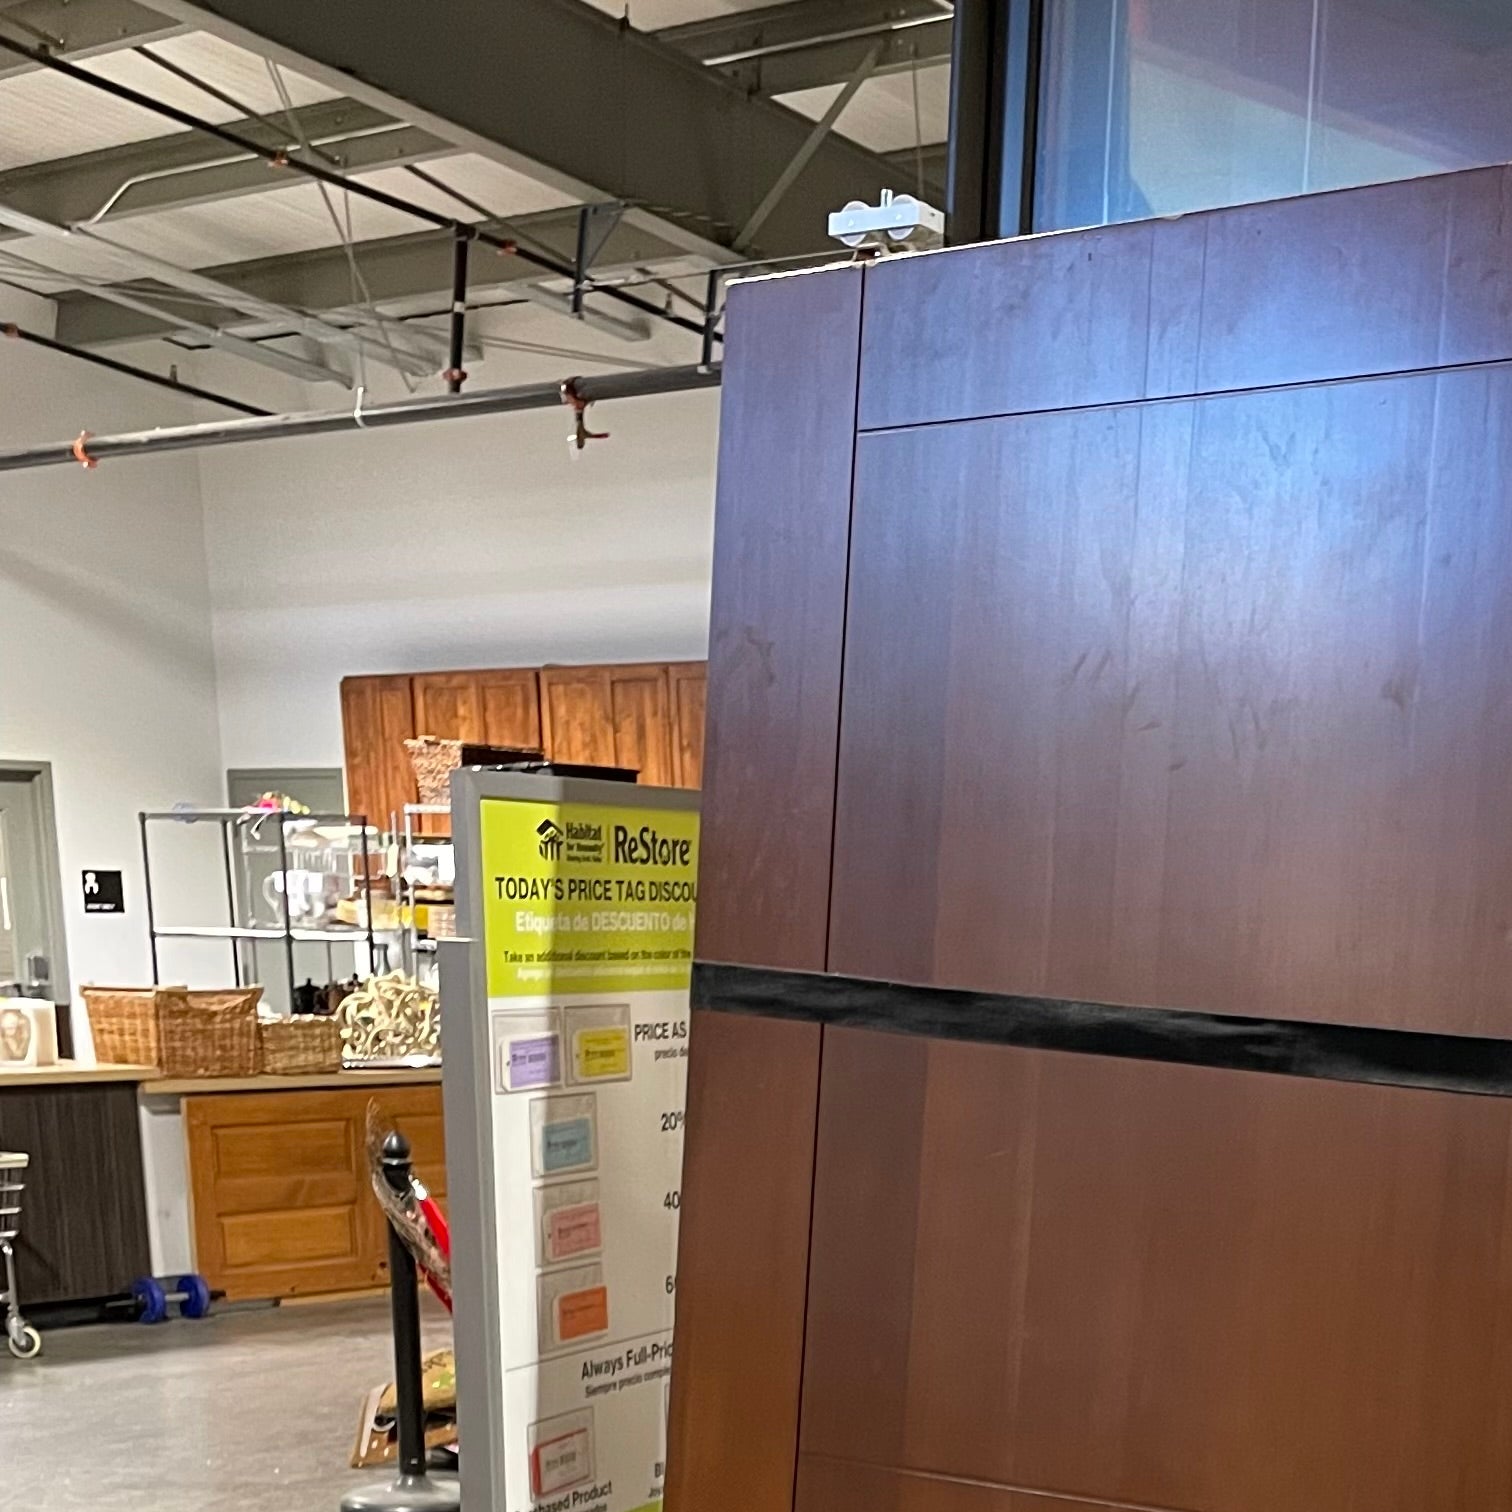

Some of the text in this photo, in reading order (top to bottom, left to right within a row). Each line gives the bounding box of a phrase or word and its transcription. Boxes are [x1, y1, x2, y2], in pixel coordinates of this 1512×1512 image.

[614, 825, 690, 866] ReStore
[495, 877, 564, 900] TODAY'S
[568, 879, 612, 901] PRICE
[615, 879, 645, 902] TAG
[516, 911, 570, 936] Etiqueta
[573, 912, 589, 932] de
[592, 911, 670, 932] DESCUENTO
[672, 913, 687, 932] de
[634, 1021, 687, 1042] PRICE AS
[665, 1275, 676, 1294] 6
[582, 1356, 624, 1380] Always
[572, 1480, 612, 1507] Product
